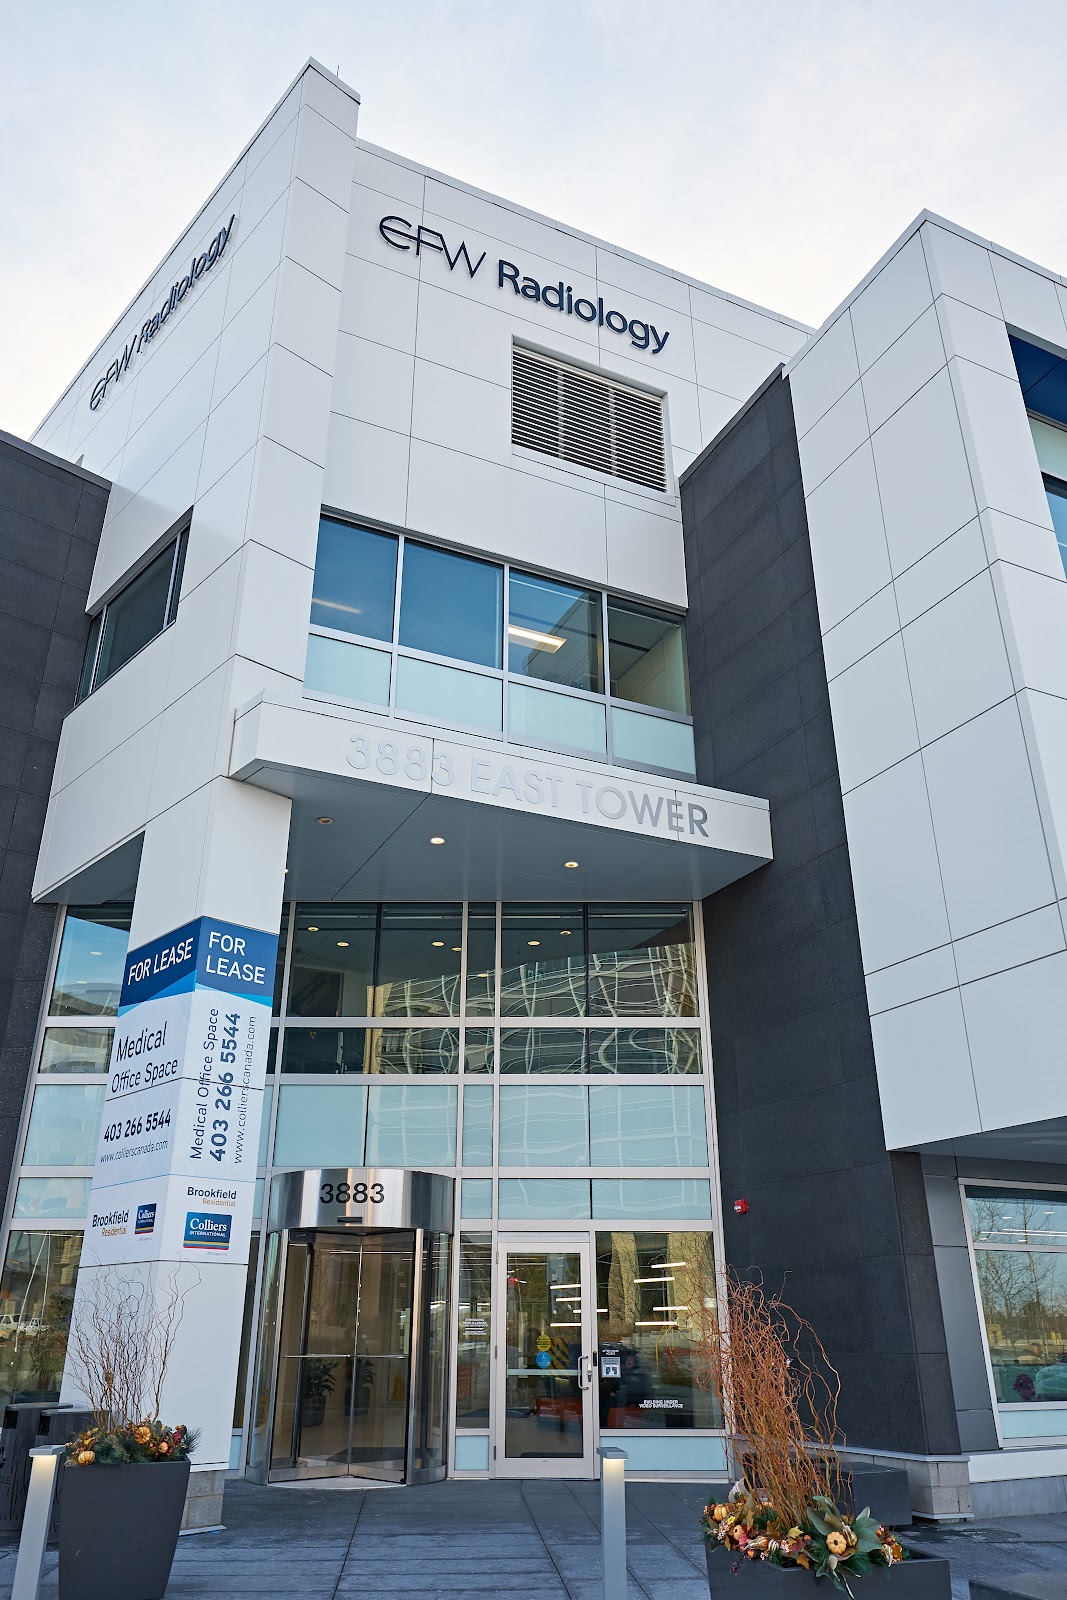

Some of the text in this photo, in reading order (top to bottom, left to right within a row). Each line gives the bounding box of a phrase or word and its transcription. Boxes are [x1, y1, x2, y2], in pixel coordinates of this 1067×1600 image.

[137, 214, 236, 353] Radiology
[379, 215, 670, 354] EFW Radiology
[345, 733, 710, 838] 3883 EAST TOWER
[208, 931, 246, 957] FOR
[127, 937, 194, 986] FOR LEASE
[205, 955, 266, 985] LEASE
[116, 1020, 168, 1063] Medical
[111, 1058, 179, 1094] Office Space
[189, 1008, 219, 1160] Medical Office Space
[209, 1013, 241, 1162] 403 266 5544
[234, 1016, 257, 1164] www.collierscanada.com
[103, 1108, 171, 1142] 403 266 5544
[100, 1140, 168, 1163] www.collierscanada.com
[187, 1186, 237, 1200] Brookfield
[202, 1198, 236, 1207] Residential
[319, 1182, 385, 1204] 3883
[92, 1209, 129, 1228] Brookfield
[101, 1225, 127, 1237] Residential
[189, 1230, 227, 1238] INTERNATIONAL
[190, 1218, 227, 1231] Colliers
